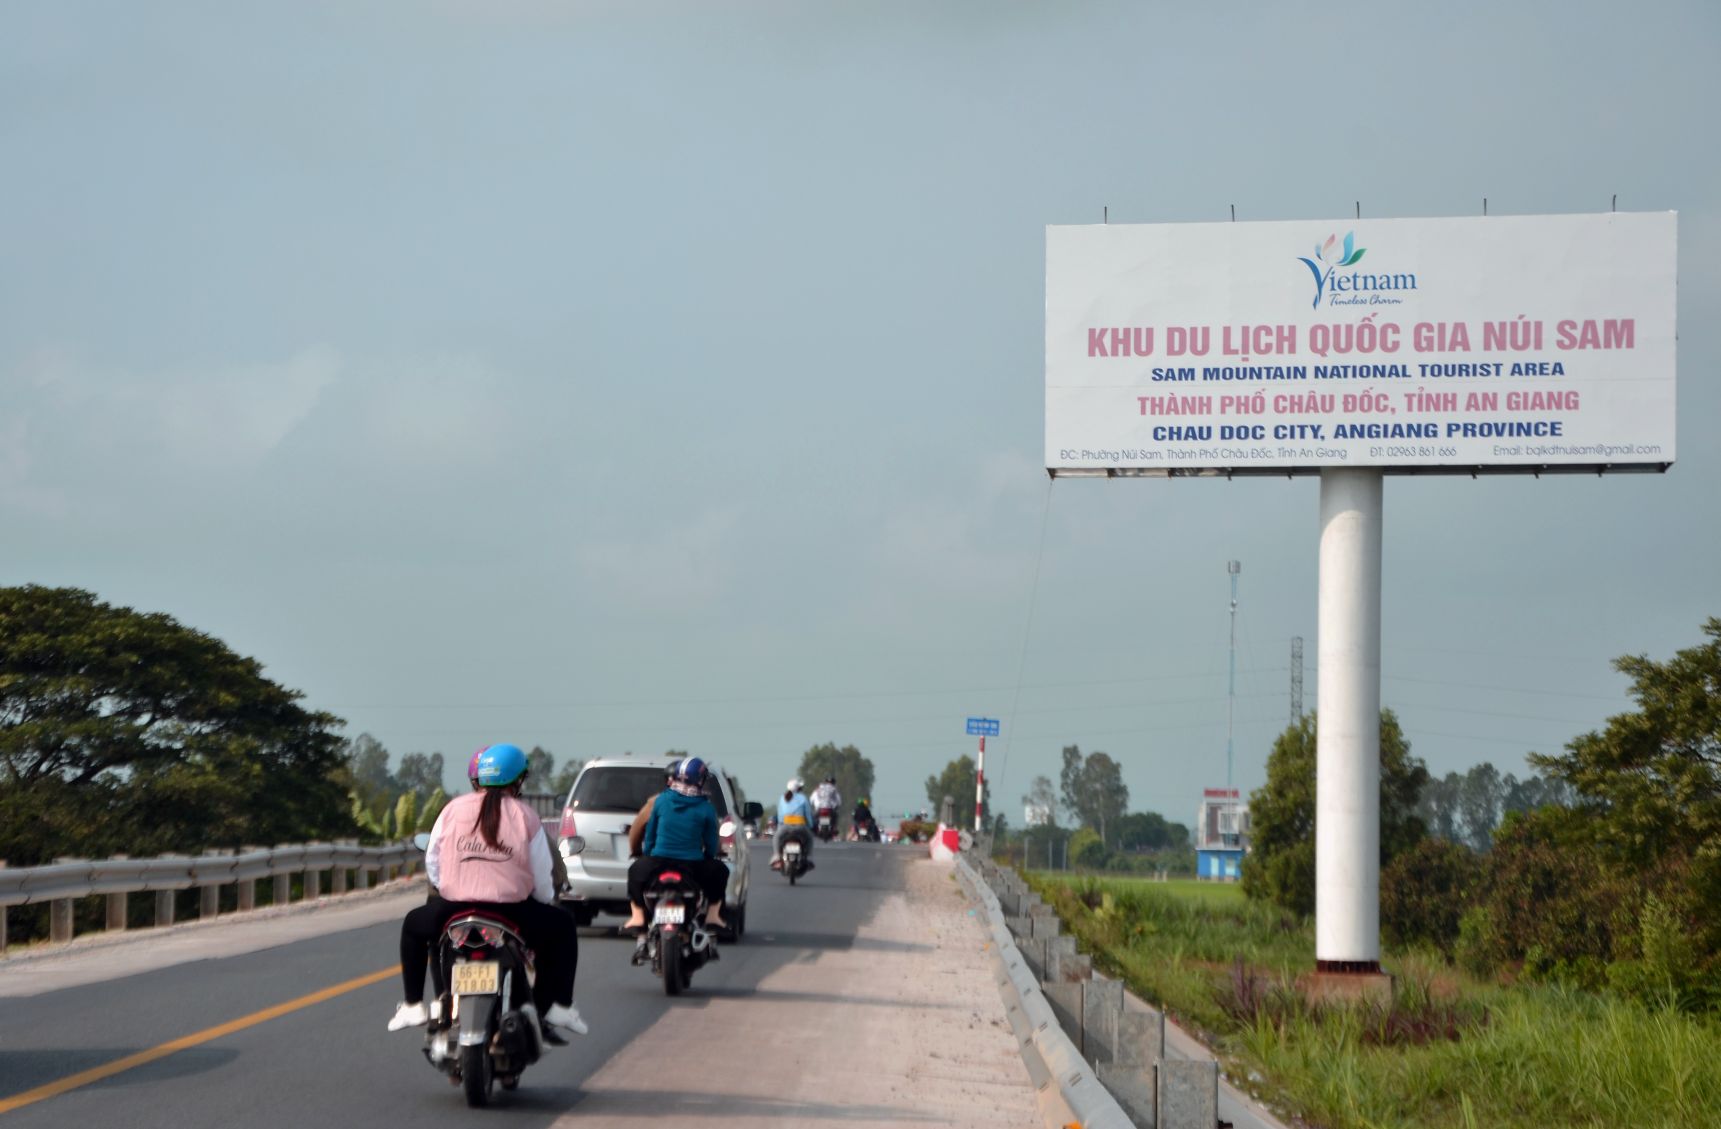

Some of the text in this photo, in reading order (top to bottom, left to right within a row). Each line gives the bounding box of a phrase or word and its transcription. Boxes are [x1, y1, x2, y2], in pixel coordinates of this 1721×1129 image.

[1296, 256, 1418, 310] Vietnam
[1329, 293, 1404, 307] Timeless Charm
[1087, 312, 1636, 363] KHU DU LỊCH QUỐC GIA NÚI SAM
[1152, 361, 1565, 381] SAM MOUNTAIN NATIONAL TOURIST AREA
[1137, 386, 1580, 416] THÀNH PHỐ CHÂU ĐỐC, TỈNH AN GIANG
[1152, 420, 1564, 442] CHAU DOC CITY, ANGIANG PROVINCE
[1060, 449, 1079, 460] ĐC:
[1121, 449, 1138, 460] Núi
[1167, 448, 1197, 460] Thành
[1199, 448, 1218, 459] Phố
[1221, 448, 1249, 459] Châu
[1300, 448, 1314, 458] An
[1315, 447, 1348, 460] Giang
[1387, 446, 1416, 457] 02963
[1418, 446, 1435, 457] 861
[1438, 446, 1457, 457] 666
[1493, 444, 1522, 456] Email:
